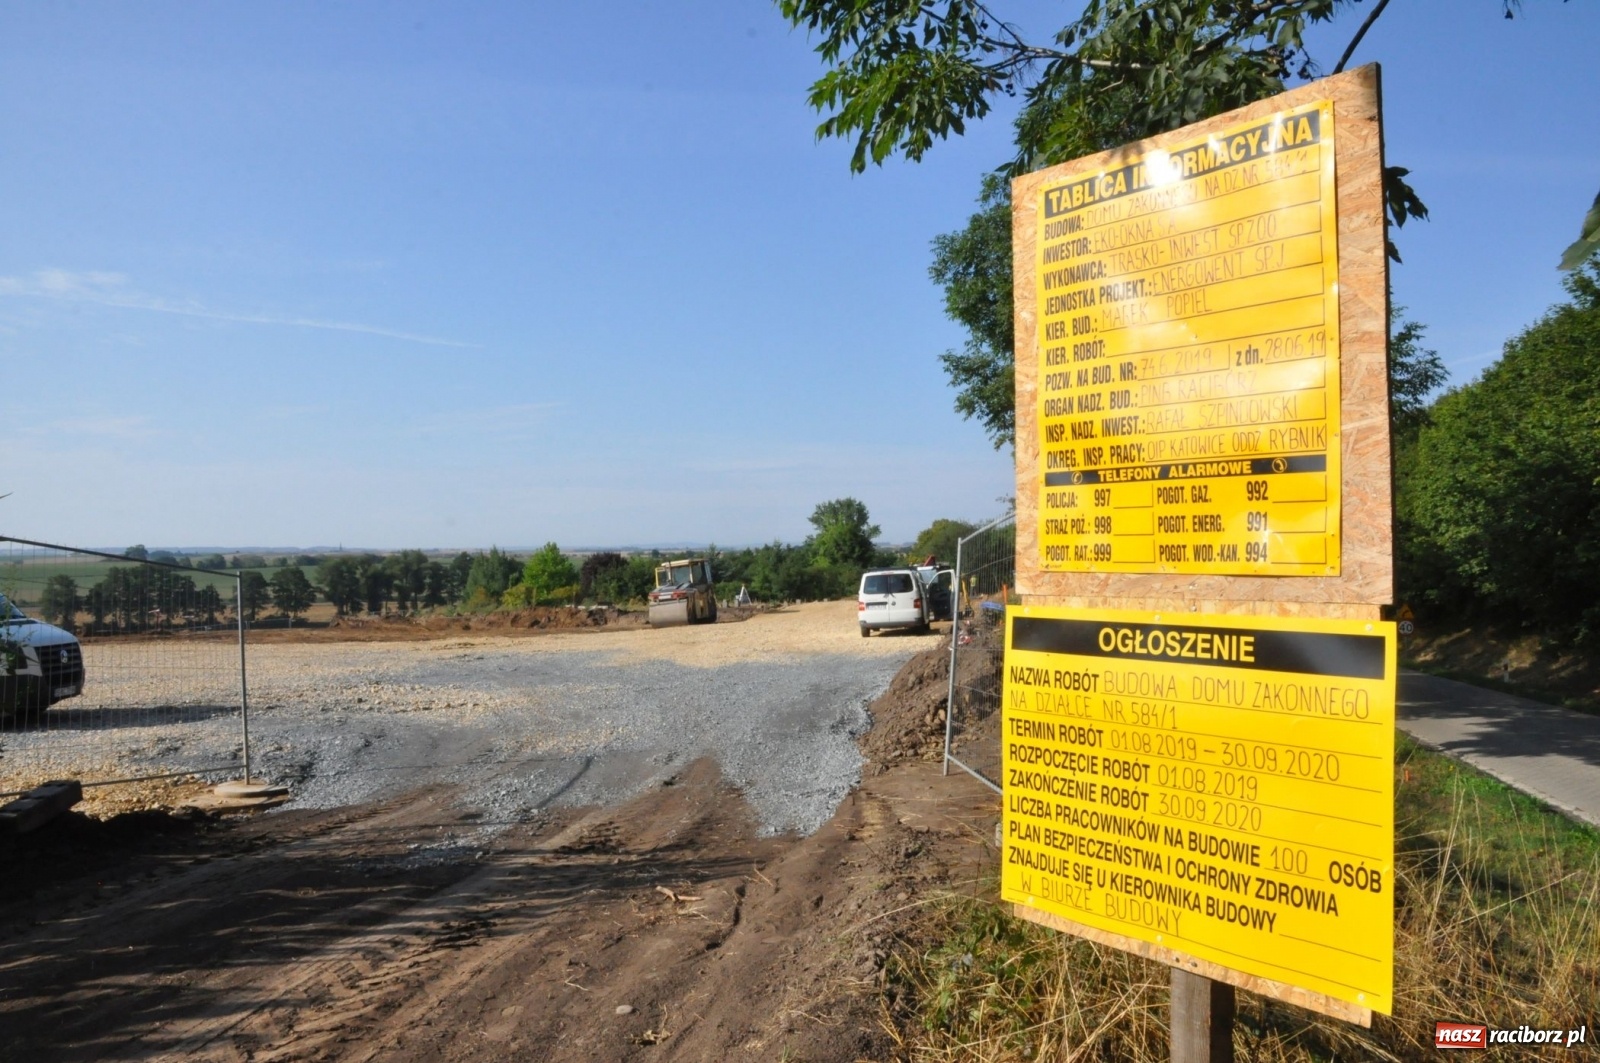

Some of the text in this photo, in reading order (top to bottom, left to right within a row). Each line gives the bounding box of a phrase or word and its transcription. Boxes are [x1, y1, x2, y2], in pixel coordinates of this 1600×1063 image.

[1049, 116, 1313, 214] TABLICA IORMACYJNA
[1045, 215, 1084, 241] BUDOWA:
[1087, 203, 1121, 225] DOMU
[1205, 176, 1221, 197] NA
[1043, 239, 1092, 264] INWESTOR:
[1094, 218, 1154, 253] EKO-OKNA
[1043, 263, 1107, 290] WYKONAWCA:
[1044, 291, 1096, 316] JEDNOSTKA
[1099, 278, 1152, 305] PROJEKT.:
[1153, 251, 1244, 295] ENERGOWENT
[1045, 317, 1069, 341] KIER.
[1166, 288, 1213, 318] POPIEL
[1045, 336, 1105, 367] KIER. ROBÓT:
[1045, 371, 1073, 391] POZW.
[1077, 369, 1089, 388] NA
[1092, 366, 1115, 384] BUD.
[1119, 364, 1137, 381] NR:
[1236, 350, 1242, 367] z
[1245, 344, 1263, 364] dn.
[1044, 395, 1074, 418] ORGAN
[1077, 393, 1106, 415] NADZ.
[1046, 423, 1068, 443] INSP.
[1071, 419, 1098, 440] NADZ.
[1102, 415, 1145, 437] INWEST.:
[1147, 407, 1189, 433] RAFAŁ
[1046, 450, 1080, 471] OKRĘG.
[1083, 447, 1107, 466] INSP.
[1110, 443, 1145, 464] PRACY:
[1148, 439, 1166, 459] OIP
[1171, 433, 1225, 457] KATOWICE
[1270, 425, 1326, 450] RYBNIK
[1098, 461, 1252, 482] TELEFONY ALARMOWE
[1157, 481, 1269, 504] POGOT. GAZ. 992
[1046, 488, 1111, 508] POLICJA: 997
[1045, 513, 1068, 535] STRAŻ
[1094, 516, 1112, 535] 998
[1158, 511, 1268, 533] POGOT. ENERG. 991
[1046, 545, 1072, 562] POGOT.
[1093, 543, 1112, 562] 999
[1159, 544, 1190, 562] POGOT.
[1245, 542, 1268, 562] 994
[1098, 627, 1255, 663] OGŁOSZENIE
[1010, 665, 1370, 720] NAZWA ROBÓT BUDOWA DOMU ZAKONNEGO
[1010, 690, 1179, 730] NA DZIAŁCE NR 584/1
[1009, 718, 1055, 742] TERMIN
[1059, 723, 1104, 748] ROBÓT
[1110, 729, 1198, 761] 01.08.2019
[1221, 741, 1340, 782] 30.09.2020
[1009, 743, 1258, 802] ROZPOCZĘCIE ROBÓT 01.08.2019
[1009, 768, 1262, 833] ZAKOŃCZENIE ROBÓT 30.09.2020
[1009, 794, 1382, 894] LICZBA PRACOWNIKÓW NA BUDOWIE 100 OSÓB
[1009, 820, 1338, 917] PLAN BEZPIECZEŃSTWA I OCHRONY ZDROWIA
[1009, 846, 1277, 933] ZNAJDUJE SIĘ U KIEROWNIKA BUDOWY
[1021, 871, 1182, 938] W BIURZE BUDOWY
